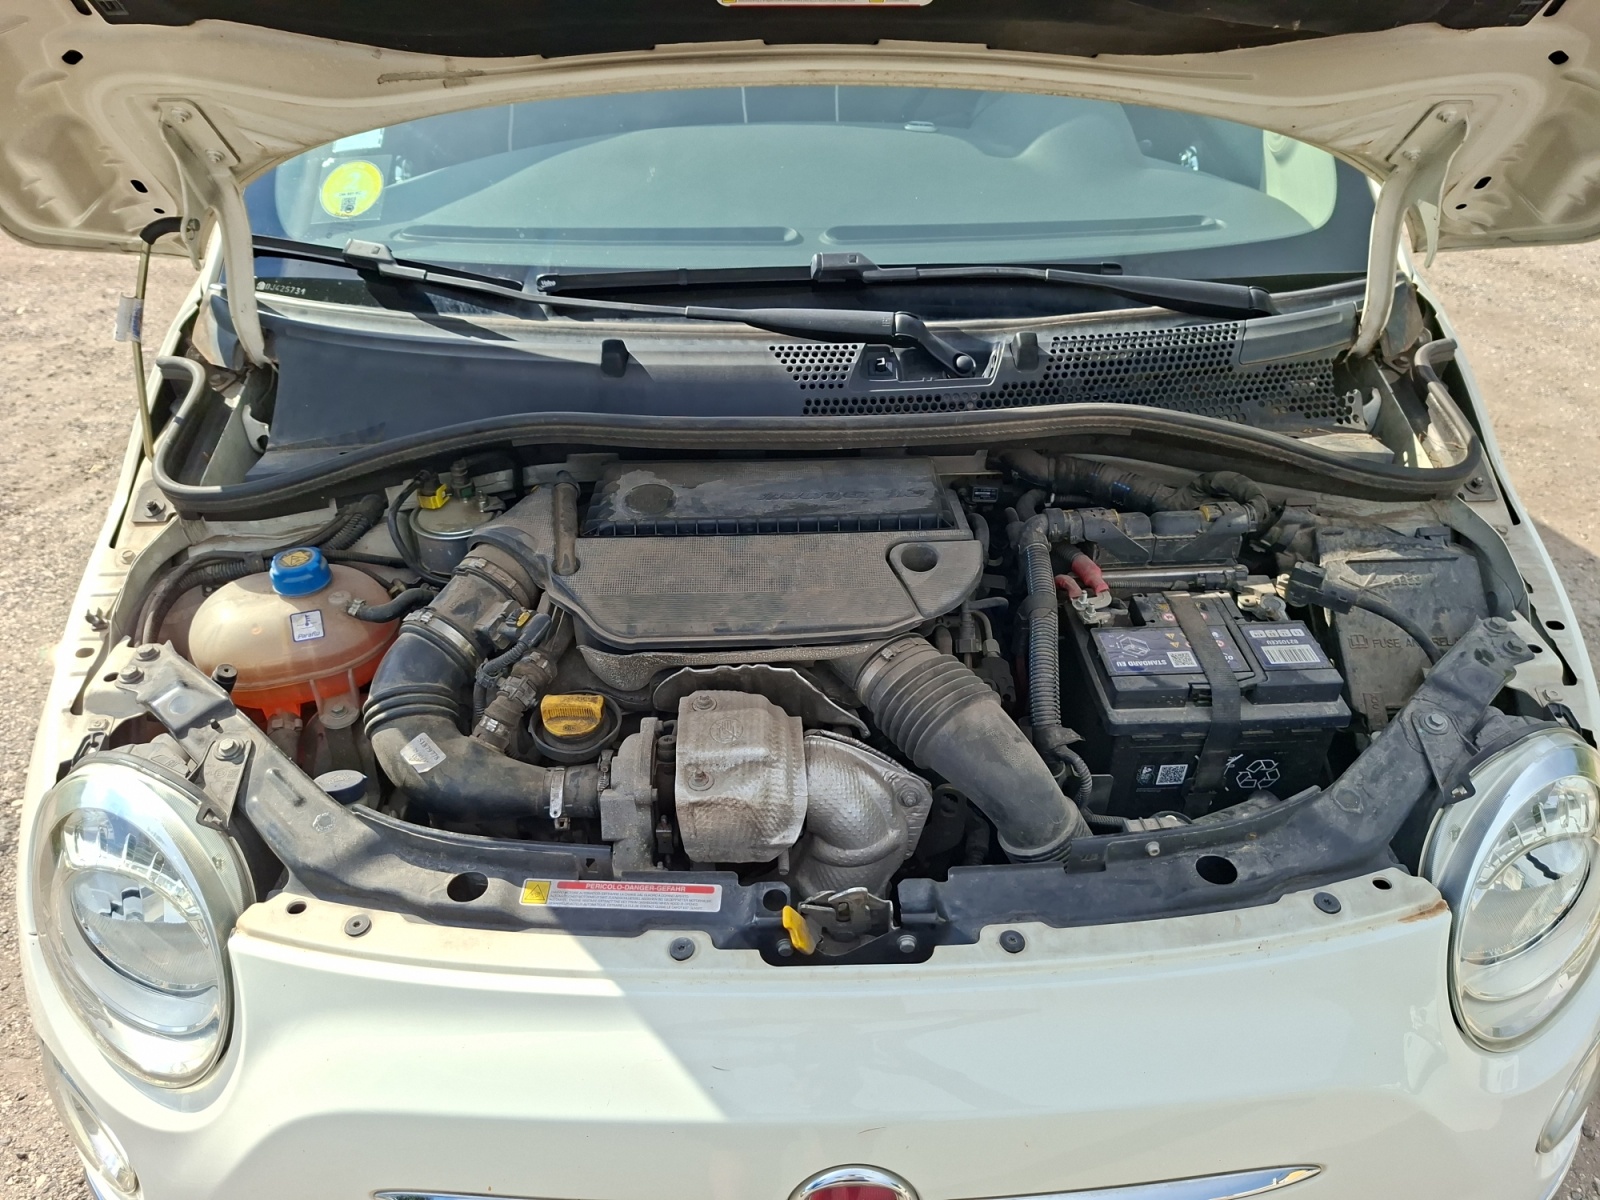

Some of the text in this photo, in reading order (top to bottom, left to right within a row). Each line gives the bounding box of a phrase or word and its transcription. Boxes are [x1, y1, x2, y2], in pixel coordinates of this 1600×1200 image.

[1372, 638, 1402, 649] FUSE
[1128, 659, 1167, 667] STANDARD
[585, 883, 687, 893] PERICOLO-DANGER-GEFAHR
